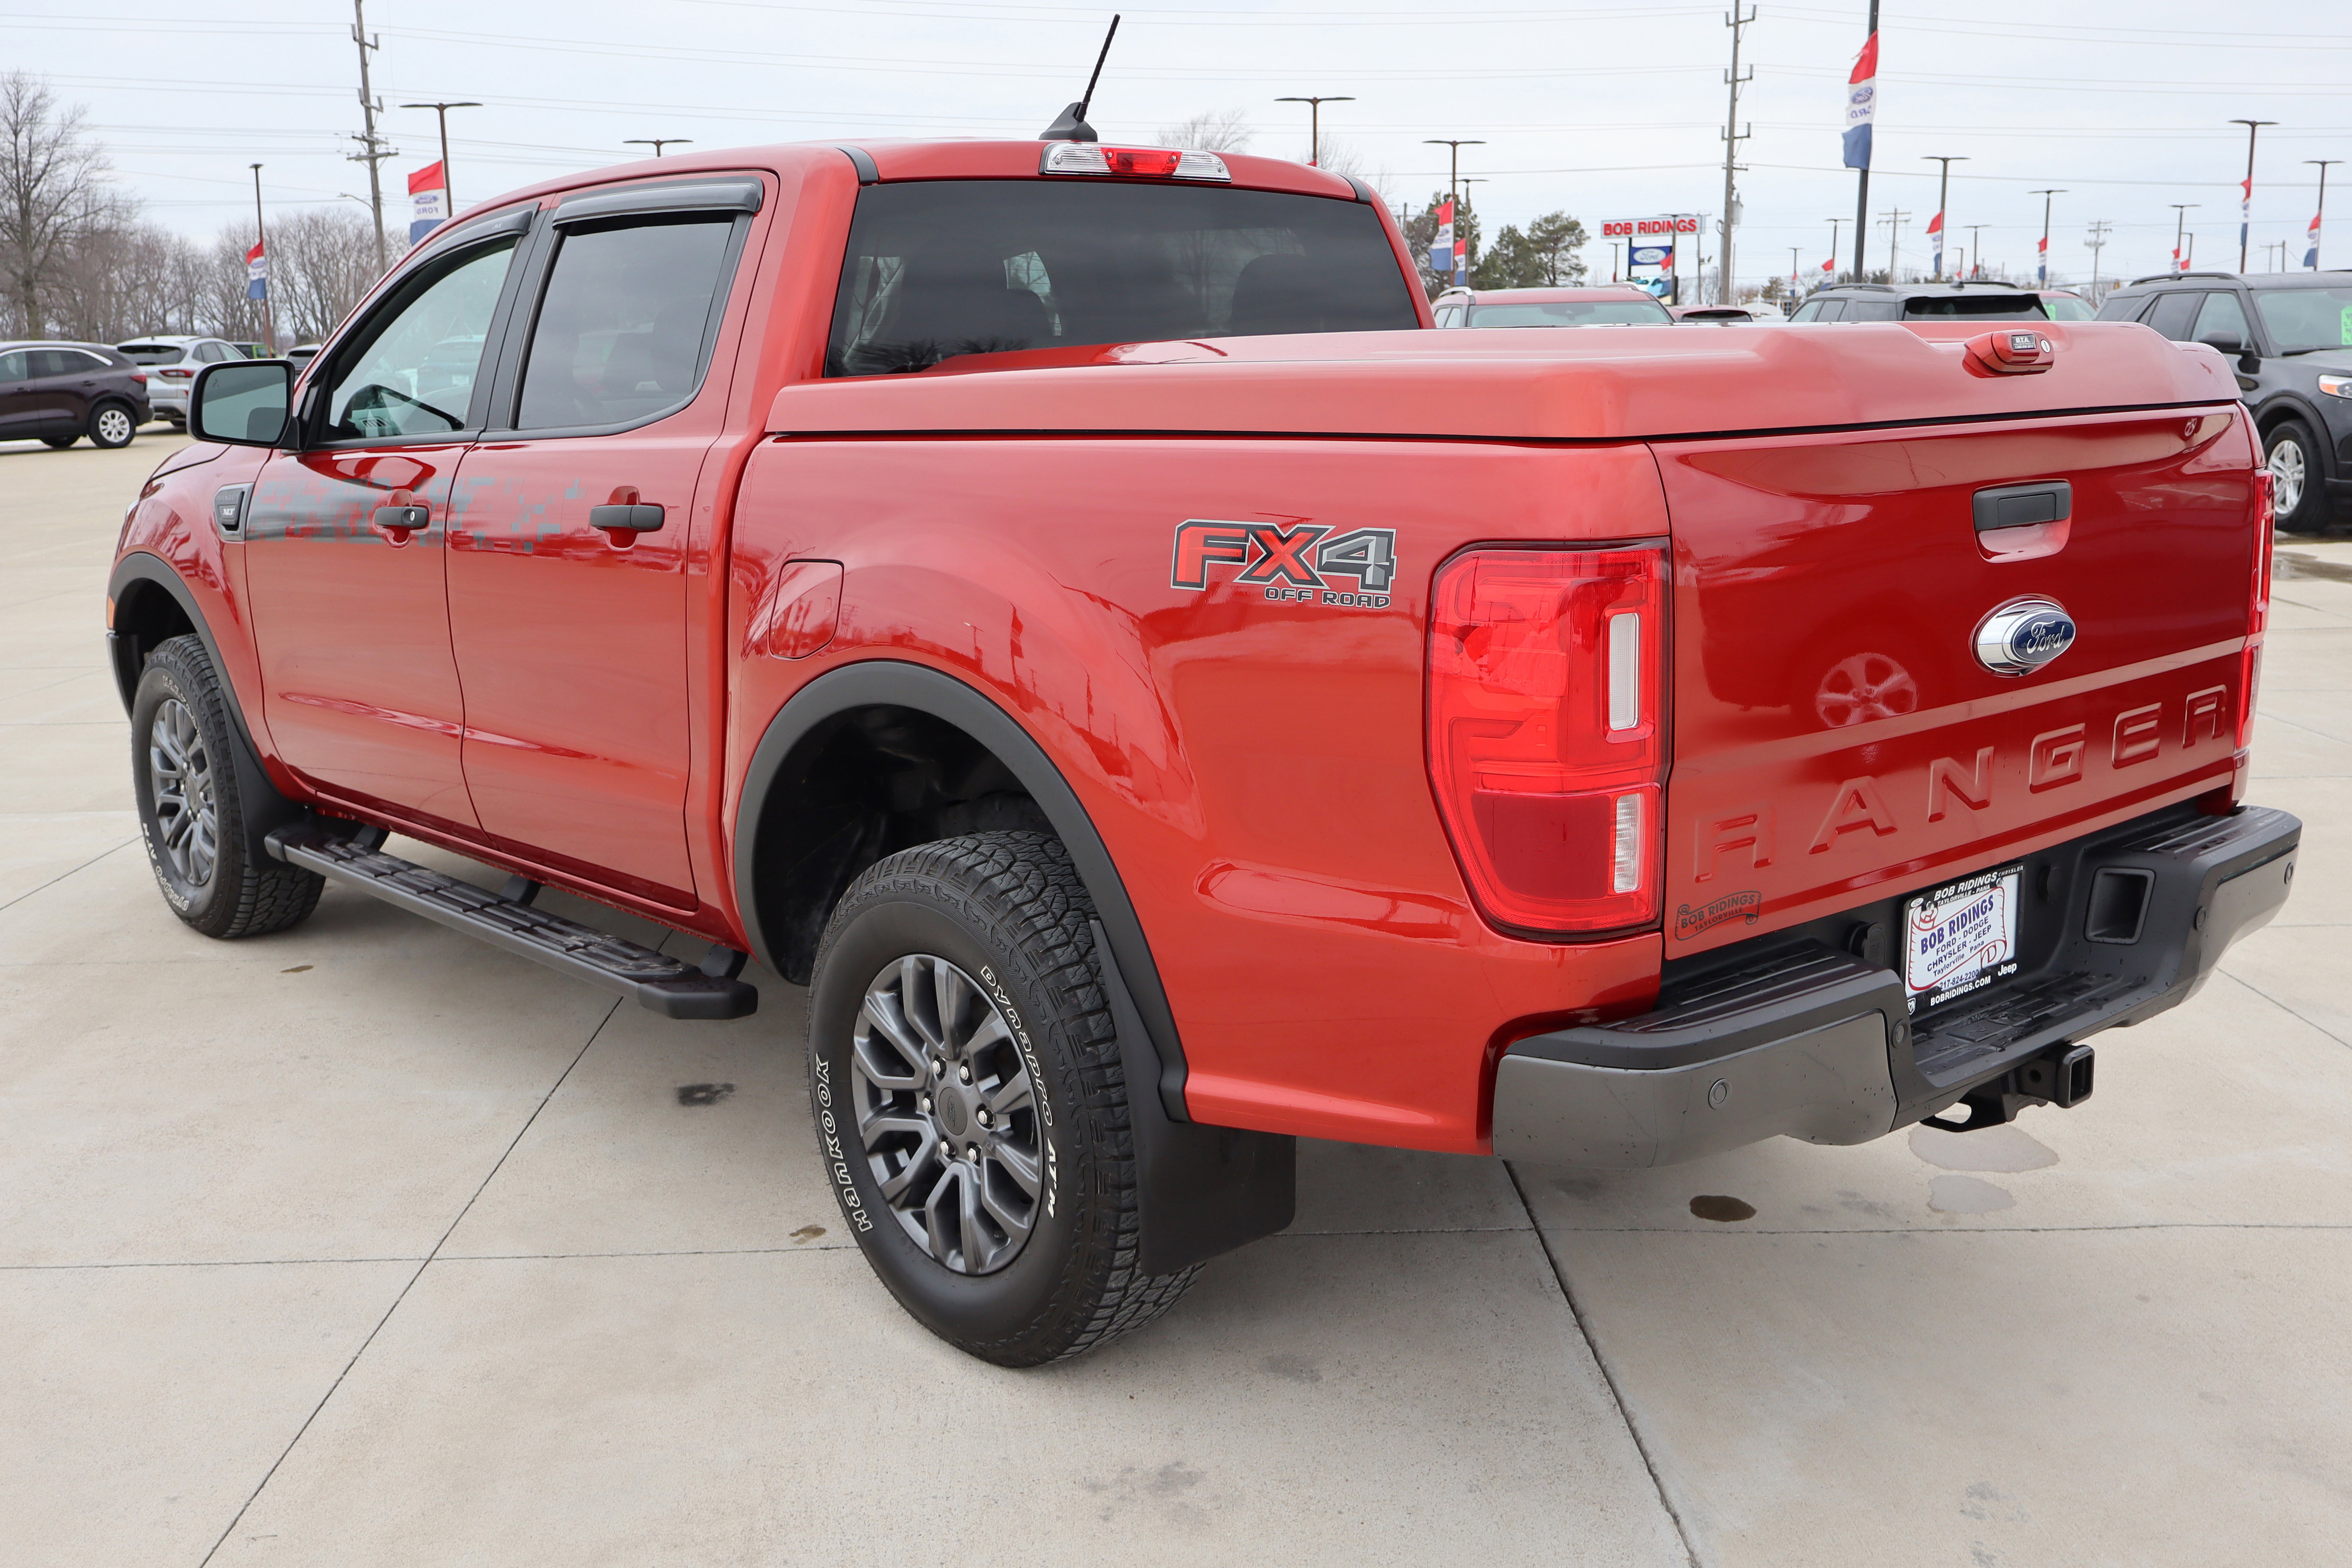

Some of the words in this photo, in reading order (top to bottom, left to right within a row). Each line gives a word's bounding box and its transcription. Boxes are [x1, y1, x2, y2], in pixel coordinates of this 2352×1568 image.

[1604, 223, 1633, 236] BOB
[1638, 219, 1697, 234] RIDINGS
[1171, 519, 1397, 594] FX4
[1265, 586, 1313, 603] OFF
[1322, 591, 1391, 609] ROAD
[2027, 620, 2065, 654] Ford
[1693, 684, 2227, 883] RANGER
[1933, 888, 1955, 901] BOB
[1958, 871, 1998, 893] RIDINGS
[1998, 865, 2024, 877] CHRYSLER
[1937, 890, 1971, 906] TAYLORVILLE
[1976, 884, 1990, 893] PANA
[1681, 910, 1704, 929] BOB
[1708, 894, 1755, 916] RIDINGS
[1694, 906, 1743, 931] TAYLORVILLE
[1921, 927, 1944, 955] BOB
[1949, 894, 1993, 937] RIDINGS
[1927, 940, 1967, 972] CHRYSLER
[1973, 924, 1991, 941] JEEP
[1936, 938, 1956, 956] FORD
[1963, 916, 1989, 938] DODGE
[1933, 953, 1964, 977] Taylorville
[1970, 940, 1984, 953] Pana
[1998, 963, 2017, 976] Jeep
[1931, 975, 1991, 1007] BOBRIDINGS.COM
[1940, 969, 1979, 990] 217-824-2200
